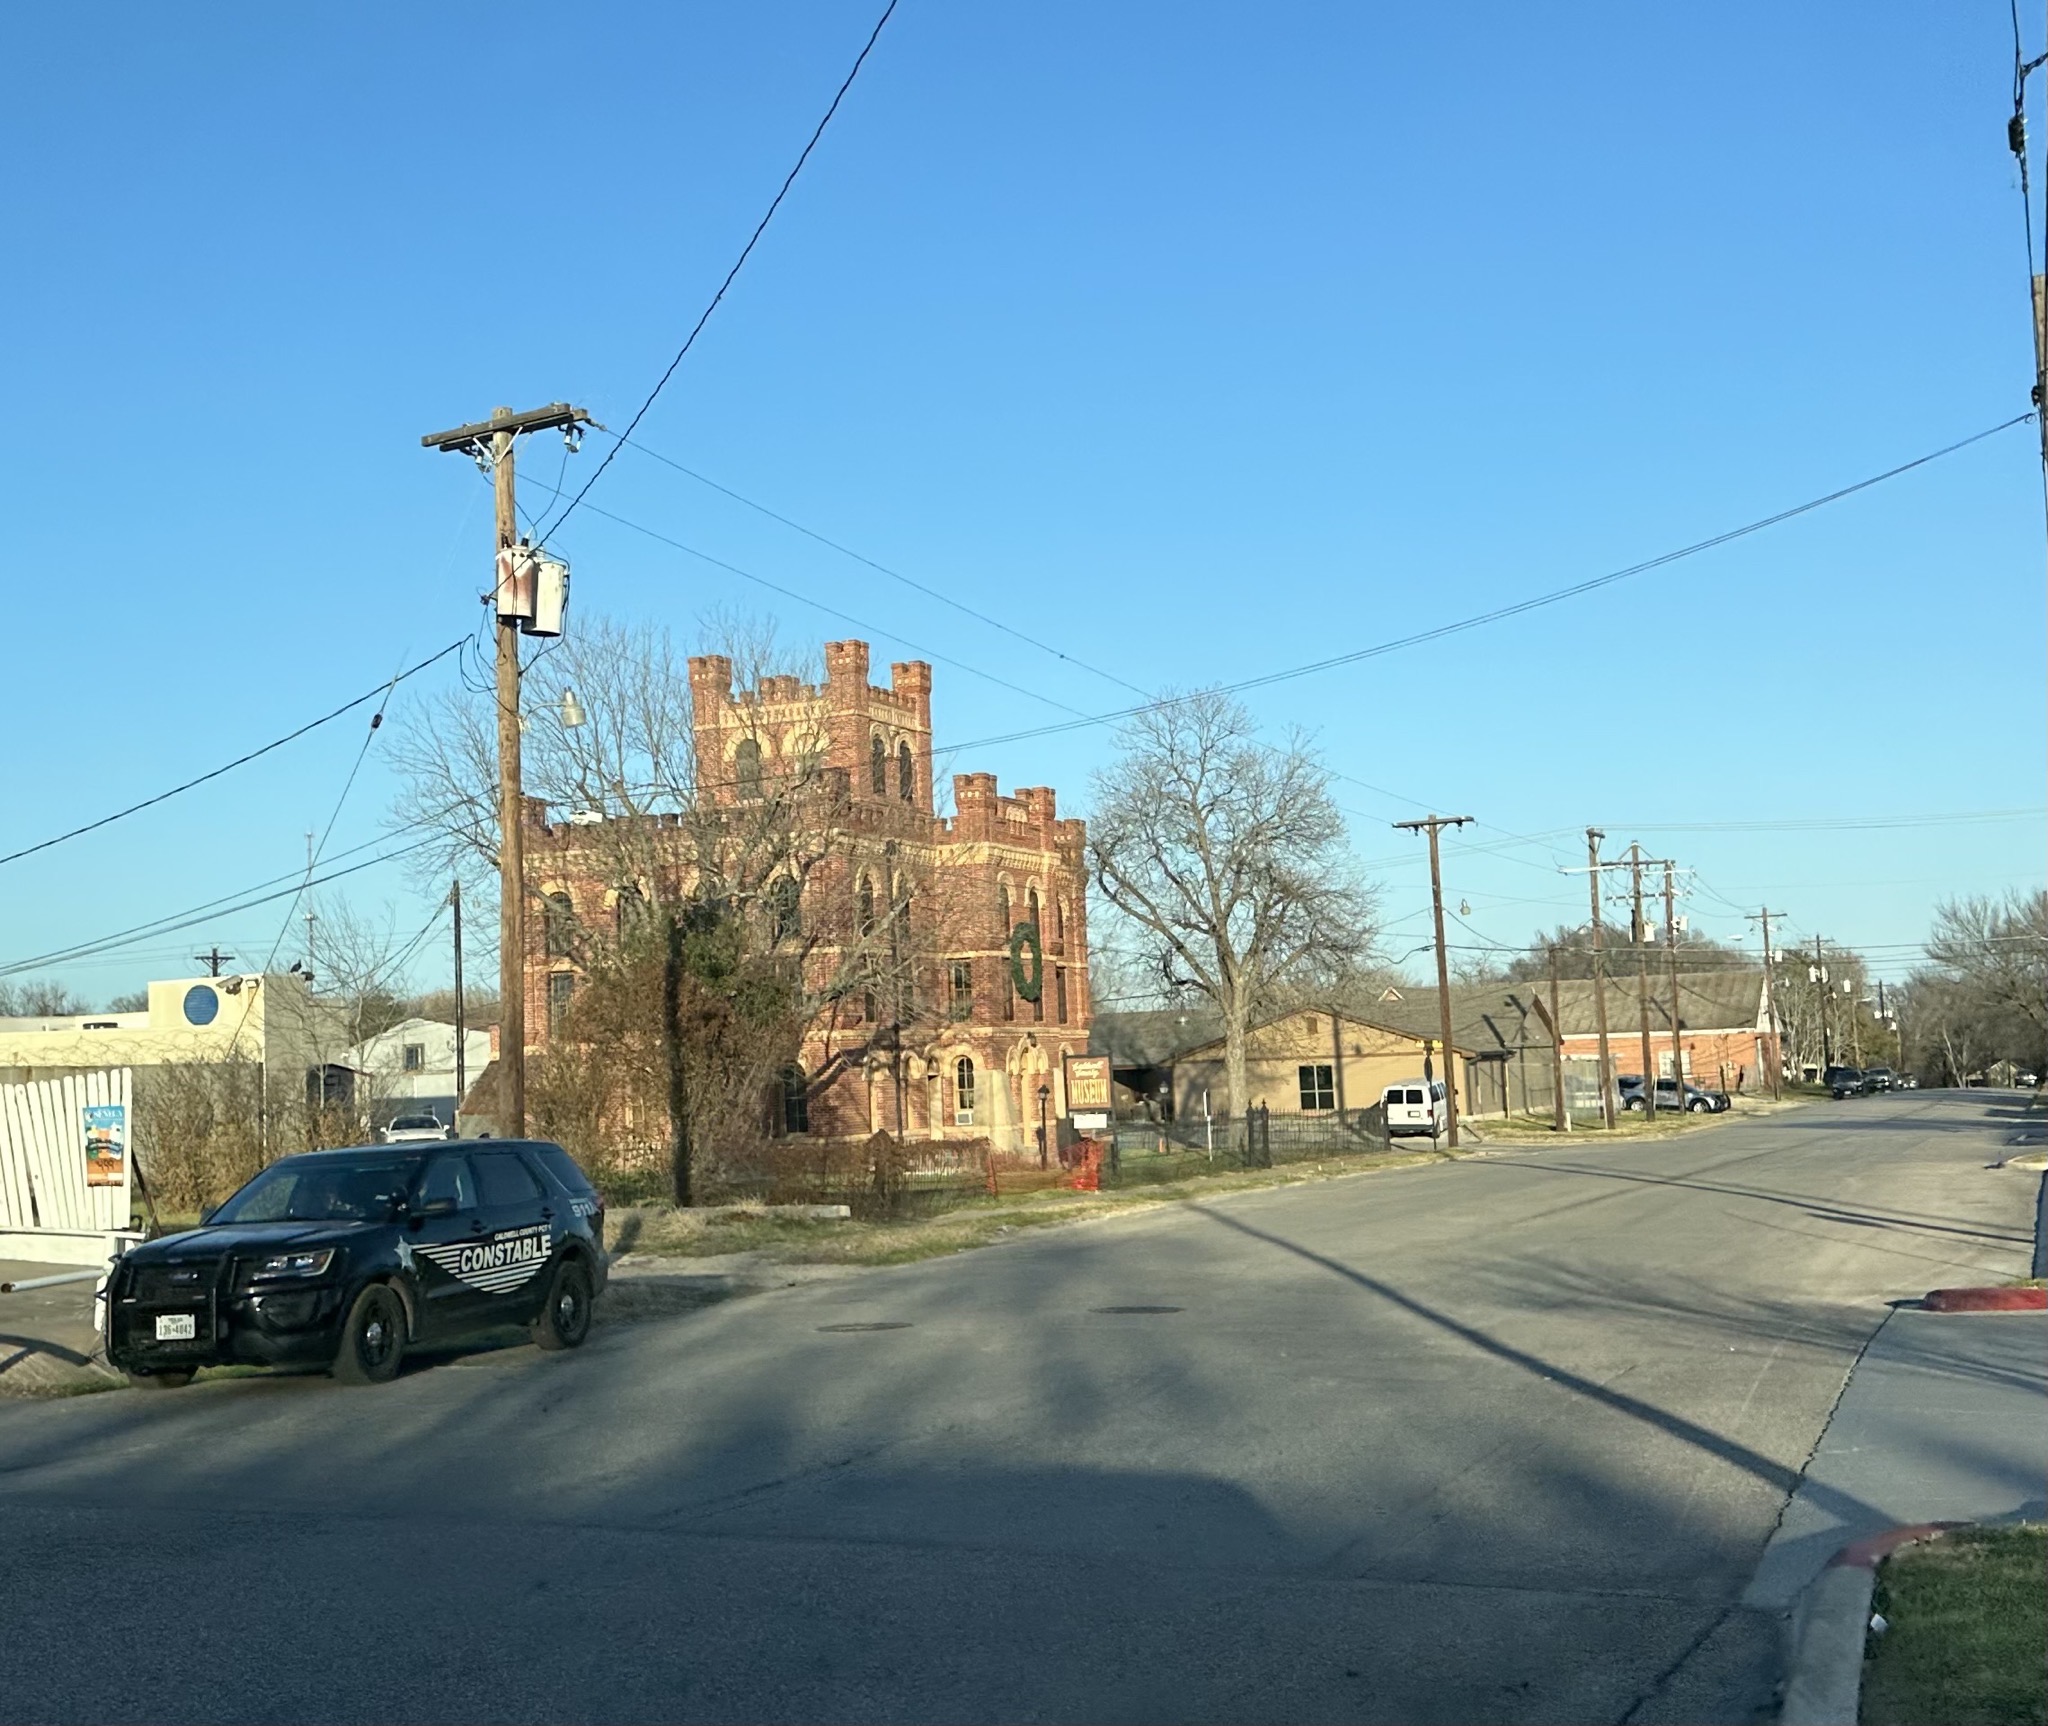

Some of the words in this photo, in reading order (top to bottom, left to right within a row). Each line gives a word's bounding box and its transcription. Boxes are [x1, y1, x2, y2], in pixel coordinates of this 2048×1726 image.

[1071, 1079, 1107, 1104] MUSEUM
[519, 1226, 538, 1236] COUNTY
[461, 1235, 552, 1272] CONSTABLE
